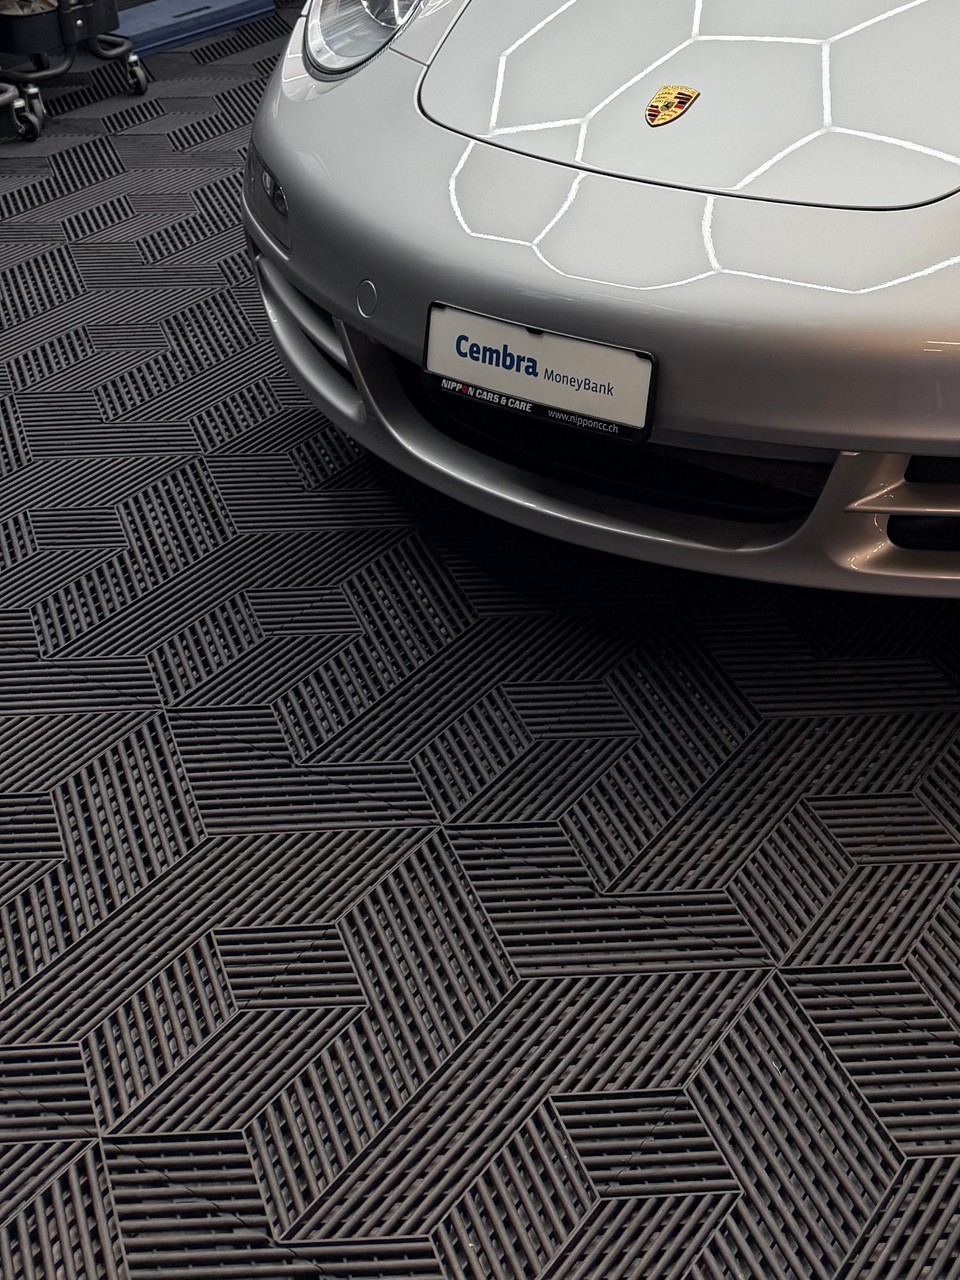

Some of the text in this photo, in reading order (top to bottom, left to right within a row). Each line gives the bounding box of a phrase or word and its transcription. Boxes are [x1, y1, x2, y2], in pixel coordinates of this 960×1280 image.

[455, 334, 614, 396] Cembra MoneyBank
[441, 378, 533, 413] NIPPON CARS & CARE
[548, 409, 619, 434] www.nipponcc.ch
